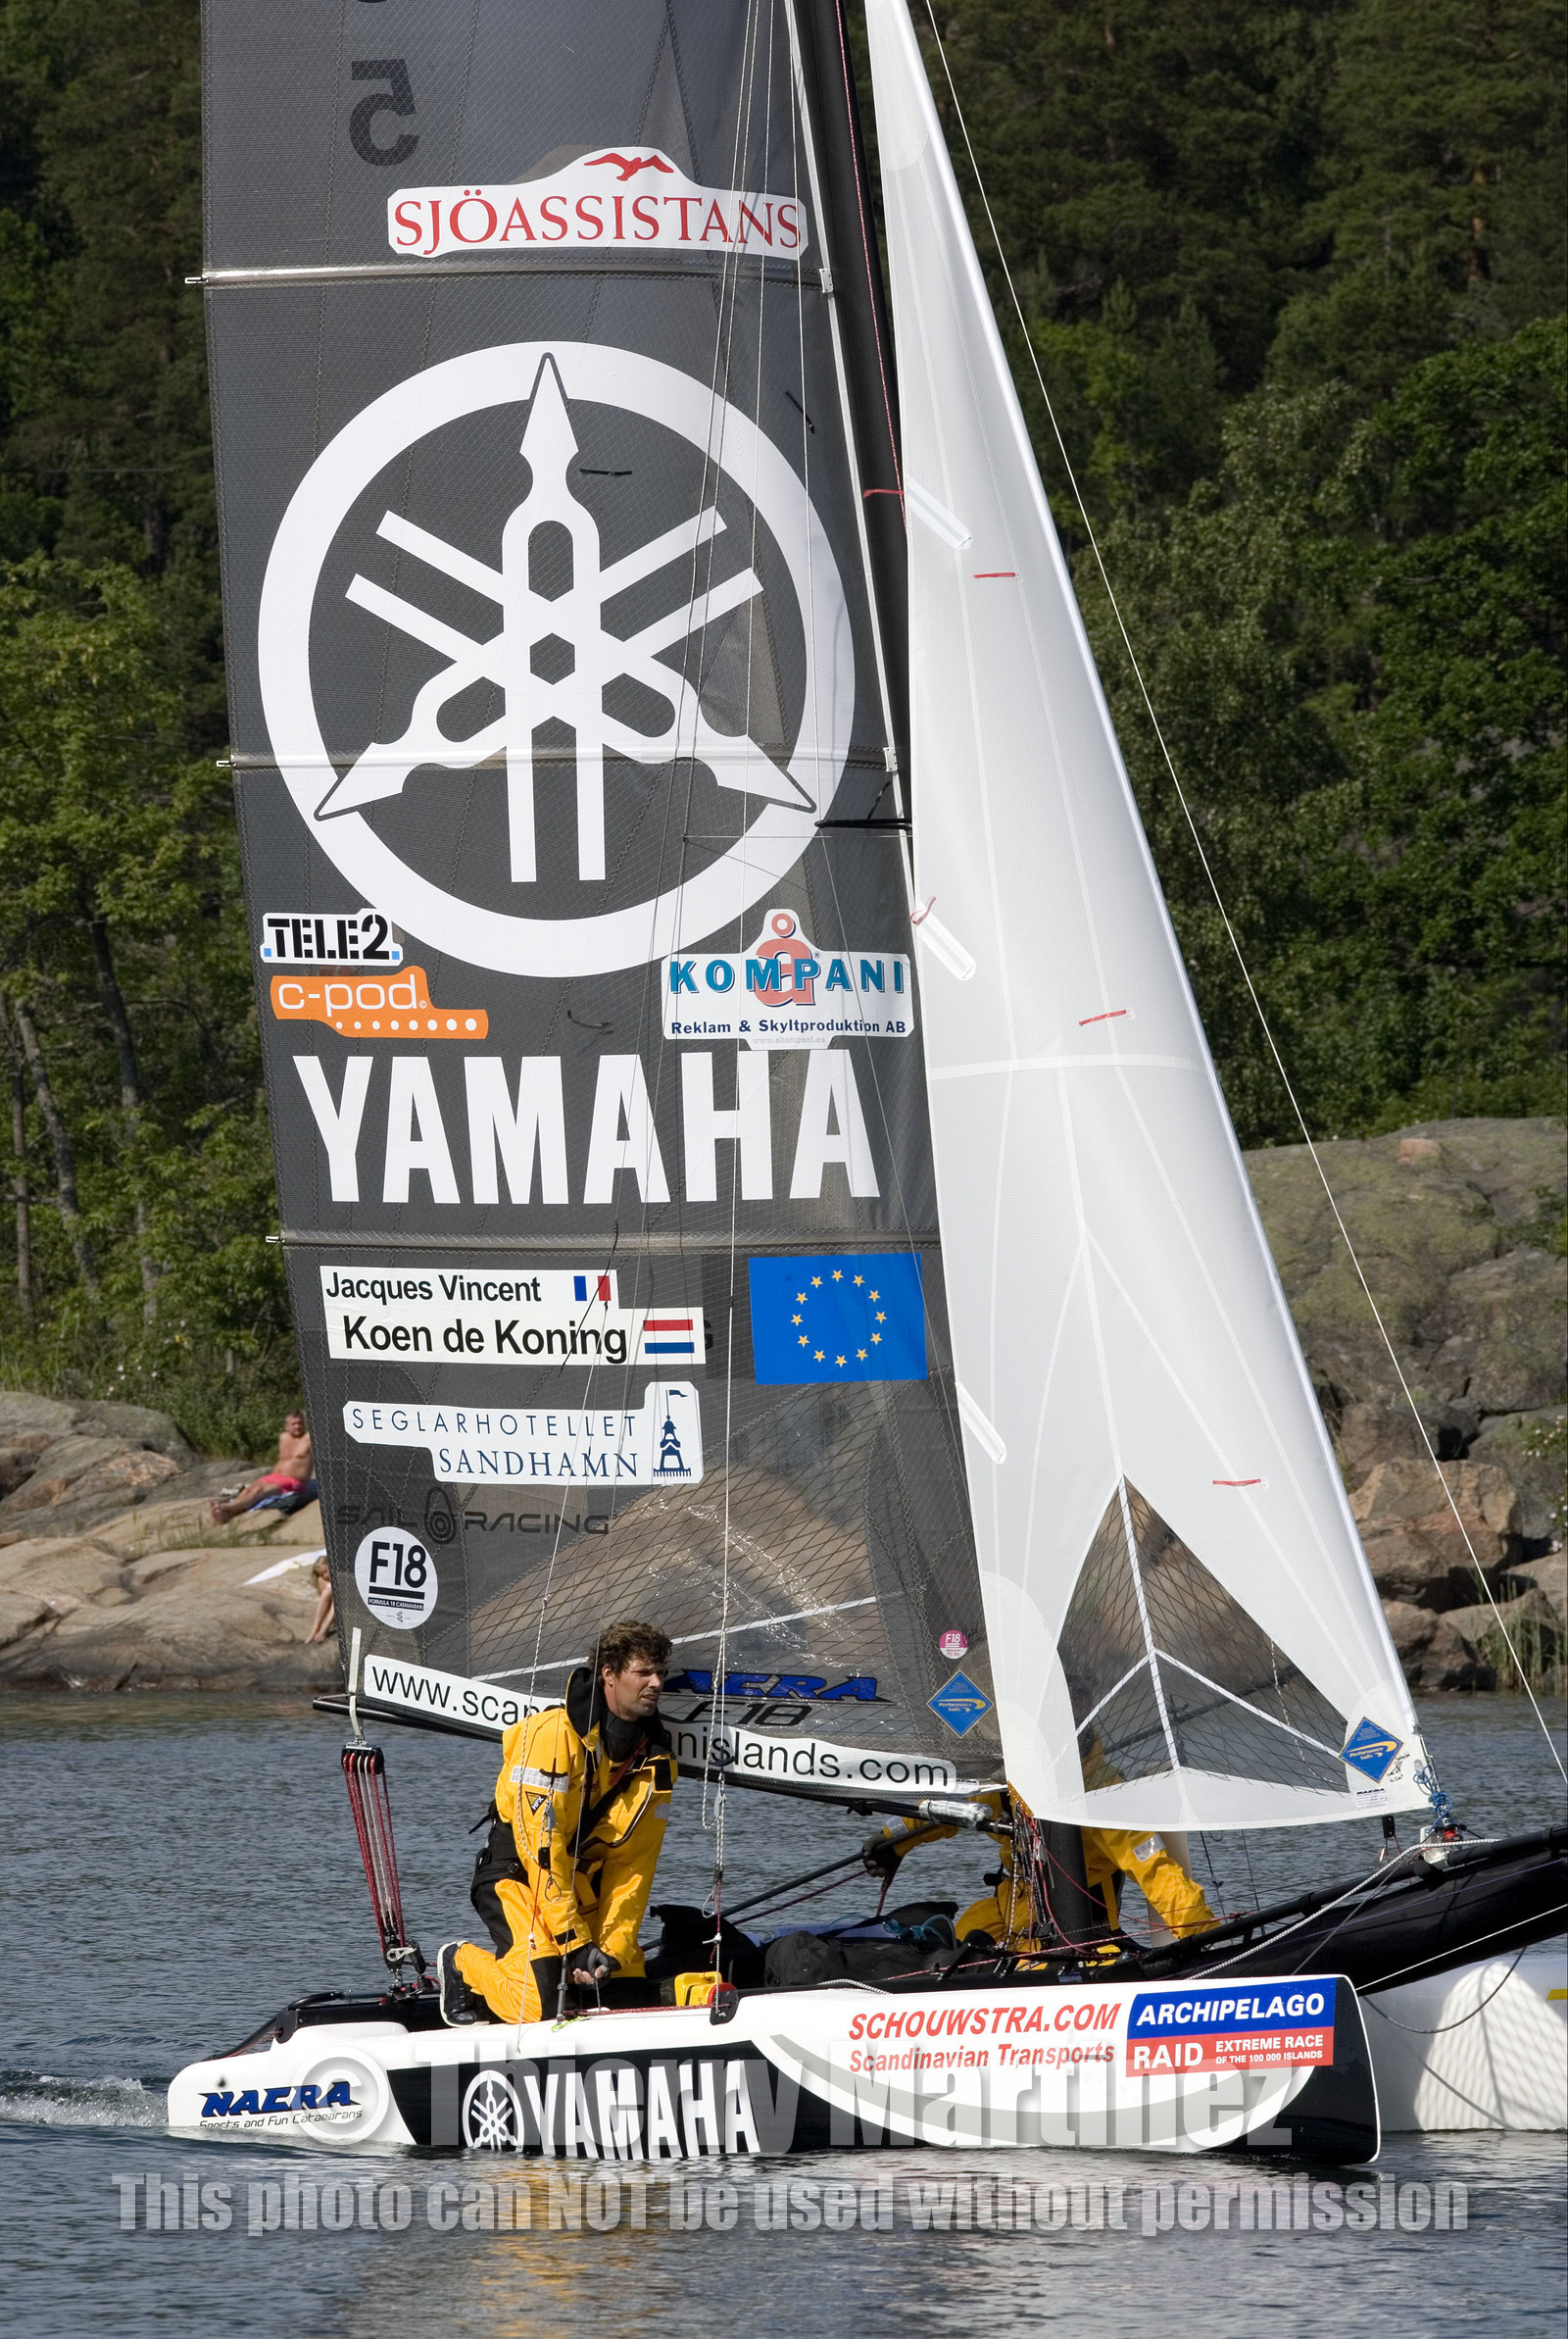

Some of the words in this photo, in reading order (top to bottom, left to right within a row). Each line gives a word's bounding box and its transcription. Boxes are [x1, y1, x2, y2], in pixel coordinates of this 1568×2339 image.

[394, 189, 802, 255] SJÖASSISTANS
[268, 914, 389, 960] TELE2
[669, 958, 905, 993] KOMPANI
[671, 1021, 731, 1034] Reklam
[739, 1020, 751, 1032] &
[759, 1019, 880, 1034] Skyltproduktion
[886, 1020, 906, 1033] AB
[293, 1049, 880, 1204] YAMAHA
[326, 1271, 433, 1306] Jacques
[438, 1274, 542, 1302] Vincent
[343, 1315, 433, 1352] Koen
[443, 1319, 485, 1354] de
[494, 1319, 628, 1364] Koning
[352, 1408, 636, 1437] SEGLARHOTELLET
[439, 1448, 639, 1478] SANDHAMN
[336, 1505, 418, 1527] SAIL
[465, 1511, 610, 1535] RACING
[369, 1540, 427, 1588] F18
[945, 1633, 961, 1643] F18
[849, 2003, 1122, 2040] SCHOUWSTRA.COM
[1136, 1993, 1325, 2026] ARCHIPELAGO
[850, 2045, 990, 2072] Scandinavian
[998, 2041, 1115, 2070] Transports
[1133, 2042, 1203, 2070] RAID
[1215, 2036, 1281, 2053] EXTREME
[1284, 2034, 1324, 2050] RACE
[1215, 2056, 1228, 2065] OF
[1229, 2055, 1247, 2064] THE
[1249, 2054, 1265, 2063] 100
[1266, 2053, 1282, 2062] 000
[1283, 2050, 1323, 2061] ISLANDS
[244, 2117, 265, 2128] and
[268, 2115, 289, 2126] Fun
[292, 2110, 363, 2124] Catamarans
[524, 2061, 760, 2161] YAMAHA
